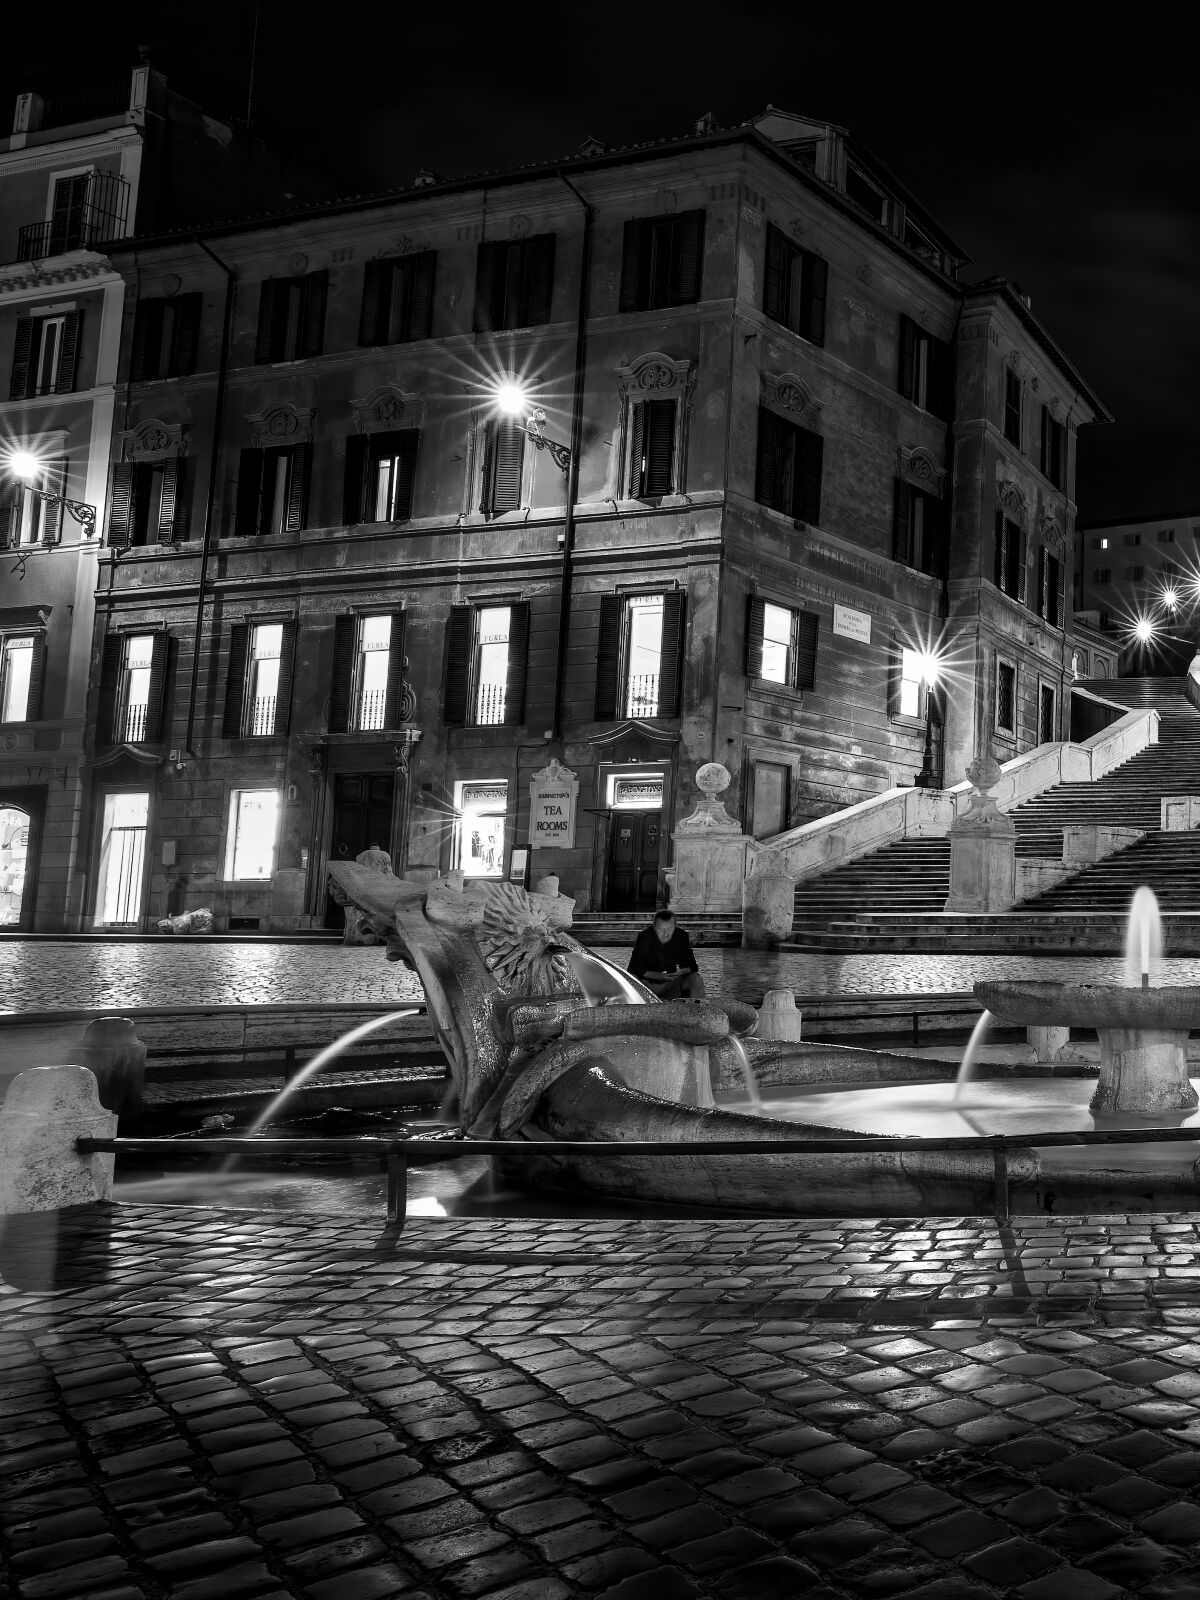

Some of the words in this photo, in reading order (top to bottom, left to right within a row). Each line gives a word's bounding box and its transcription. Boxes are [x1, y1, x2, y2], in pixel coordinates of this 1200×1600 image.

[484, 634, 509, 643] FURLA
[543, 806, 562, 815] TEA
[536, 821, 568, 831] ROOMS
